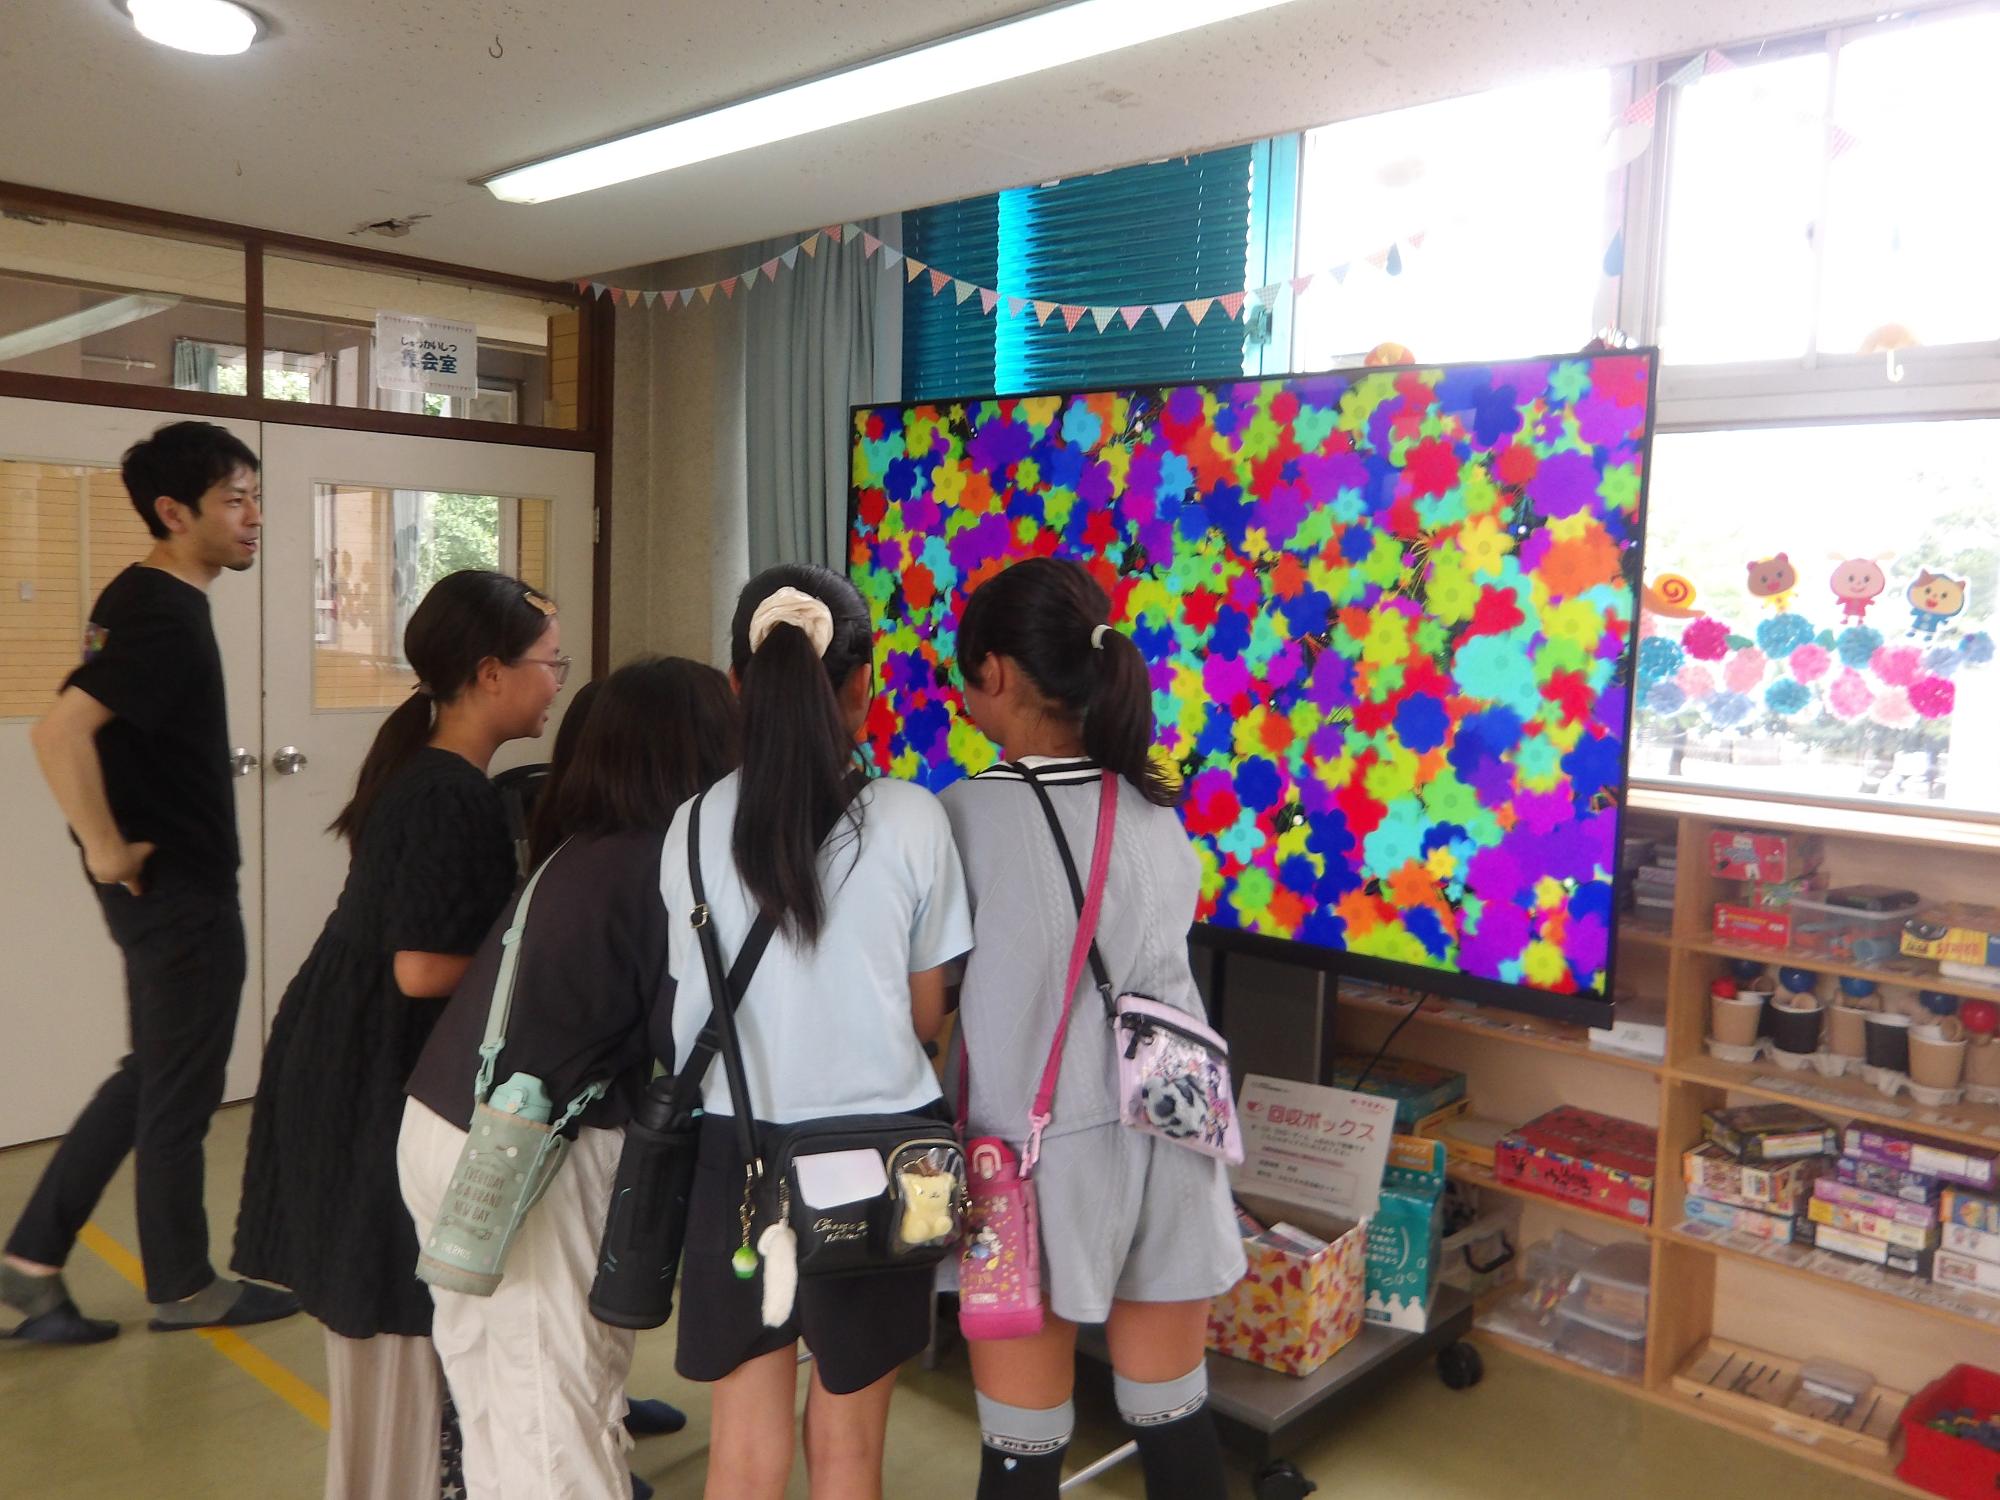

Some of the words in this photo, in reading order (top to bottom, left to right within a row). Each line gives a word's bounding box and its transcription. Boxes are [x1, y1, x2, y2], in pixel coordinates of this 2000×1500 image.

[1267, 1105, 1376, 1141] 回収ボックス
